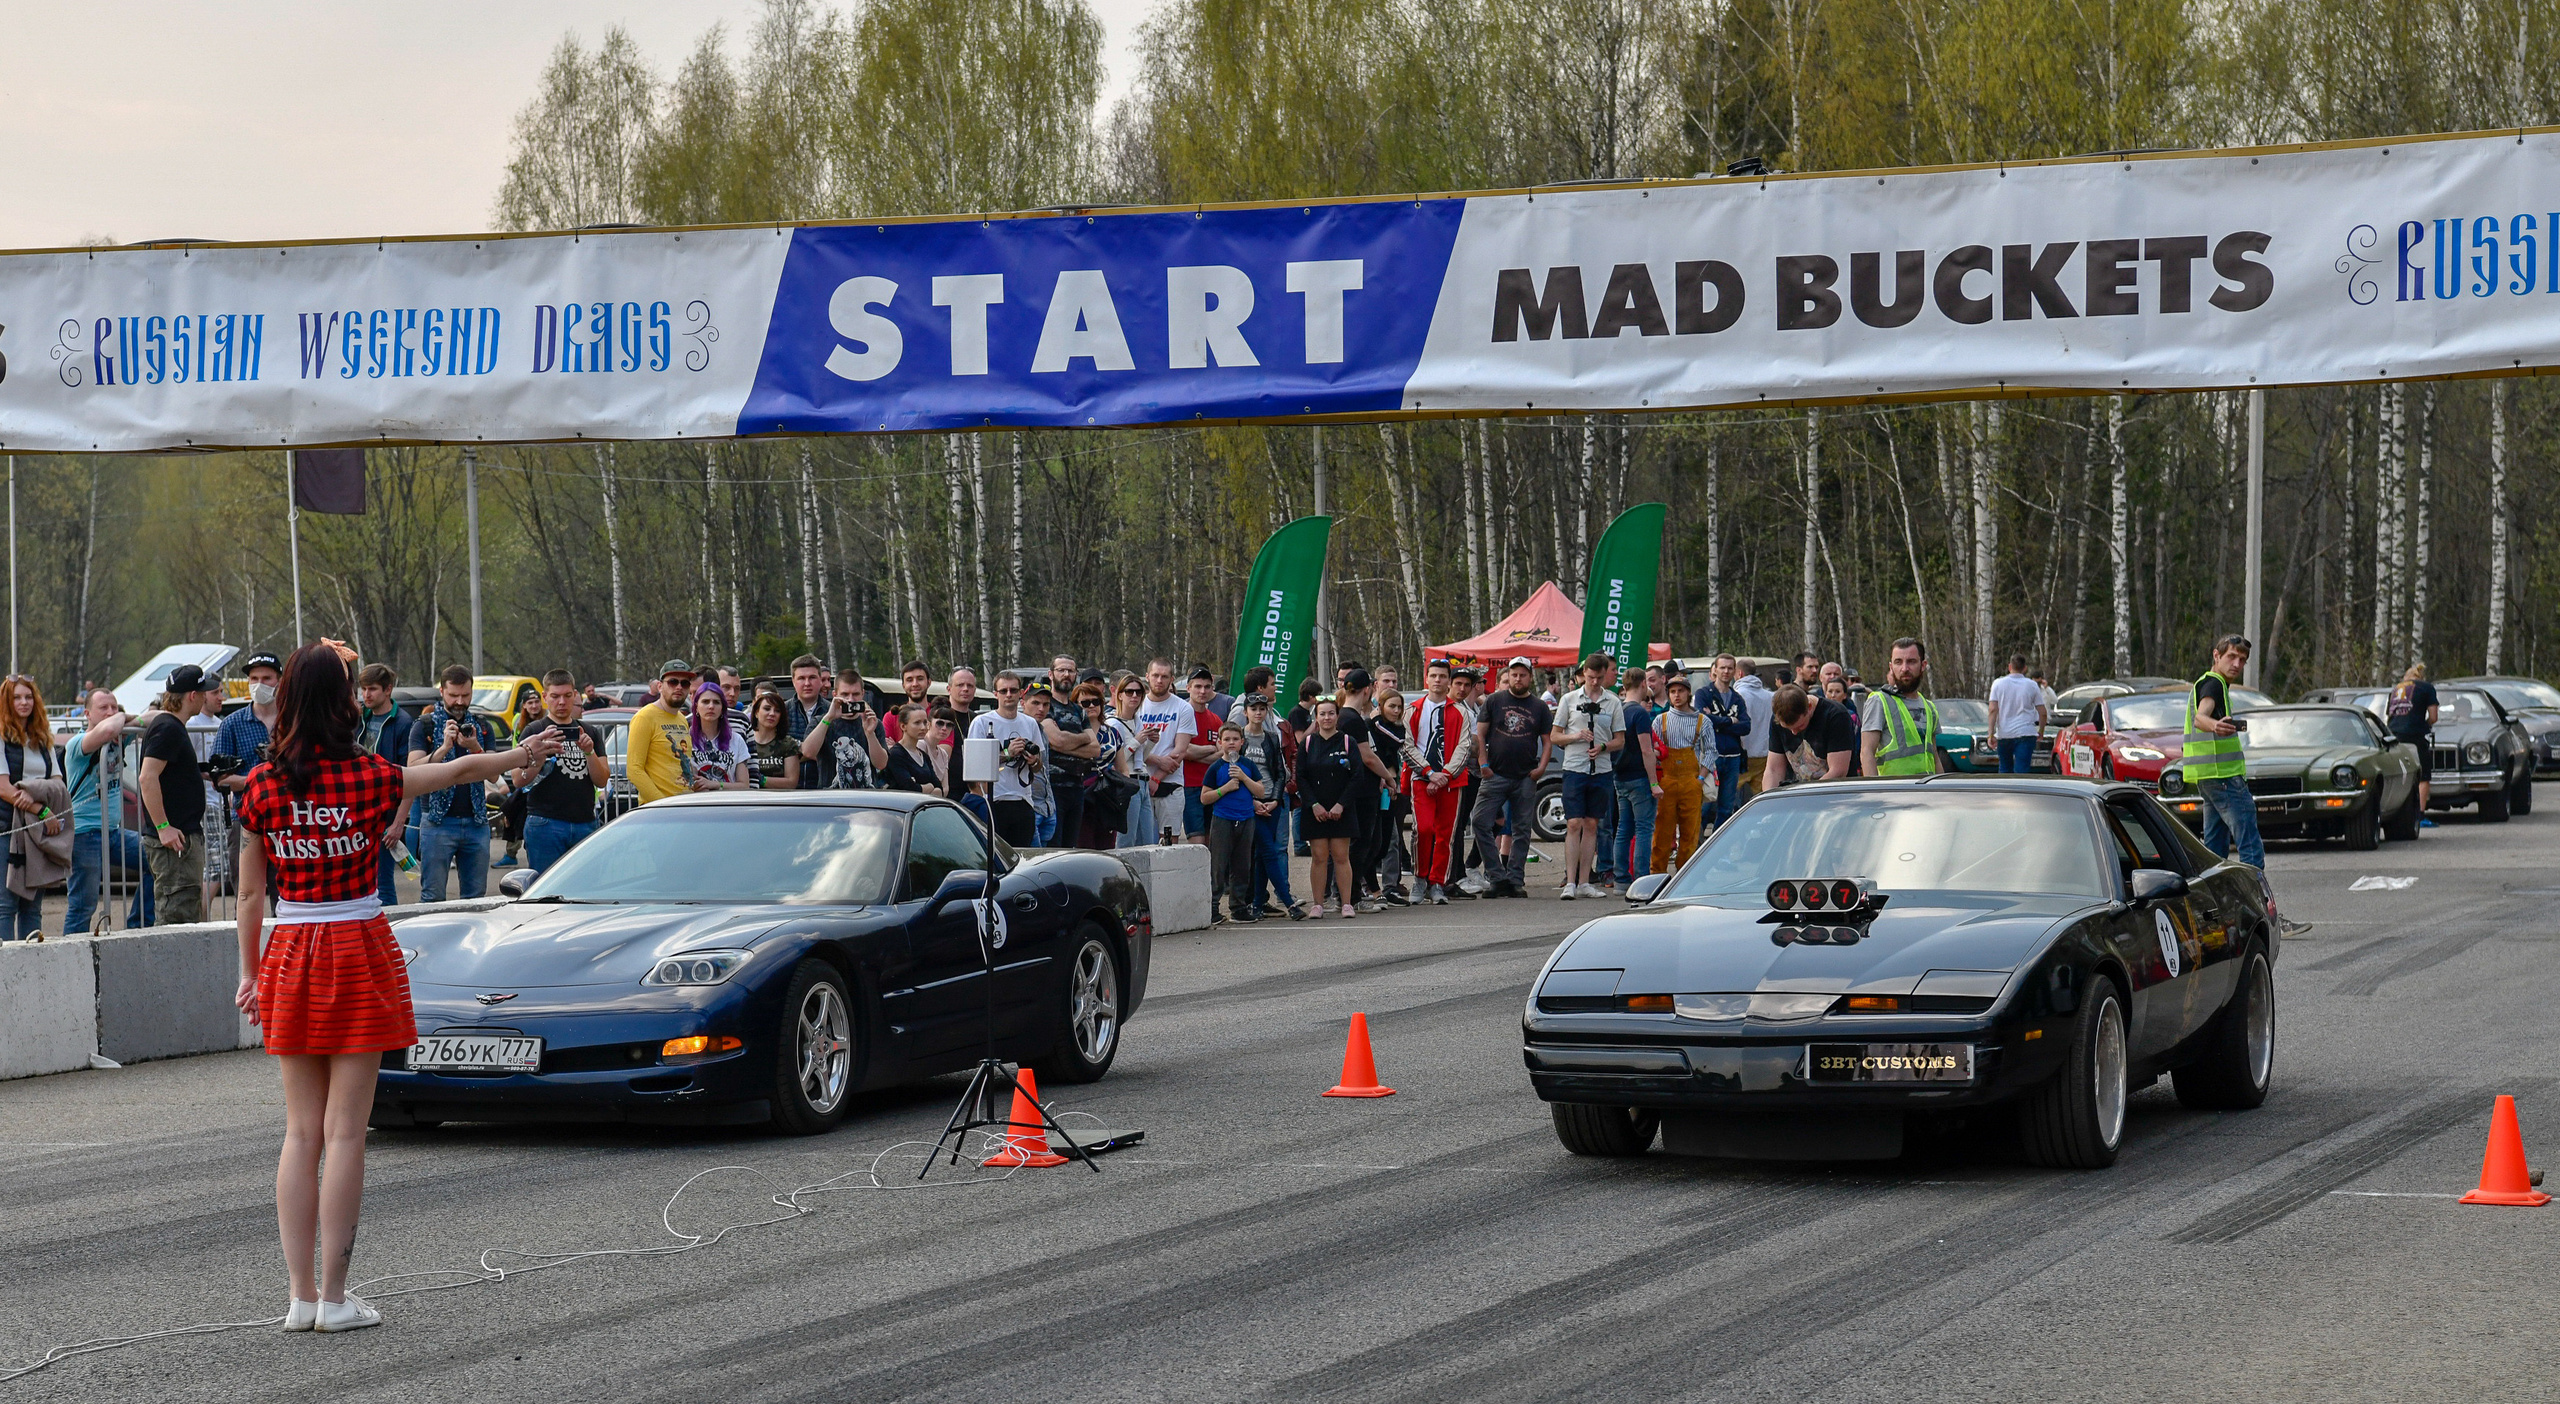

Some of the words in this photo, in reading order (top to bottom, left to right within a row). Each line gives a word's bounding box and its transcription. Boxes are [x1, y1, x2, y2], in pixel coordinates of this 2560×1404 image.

[1490, 259, 1746, 343] MAD
[1775, 230, 2274, 331] BUCKETS
[824, 258, 1364, 382] START
[93, 313, 265, 386] RUSSIAN
[299, 307, 501, 380] WEEKEND
[532, 301, 671, 373] DRAGS
[1259, 589, 1284, 666] EEDOM
[1602, 578, 1624, 657] EEDOM
[757, 755, 784, 766] nité
[289, 800, 354, 832] Hey,
[324, 831, 370, 859] me.
[2160, 922, 2174, 953] 11
[501, 1038, 535, 1058] 777
[506, 1057, 524, 1065] RUS
[1820, 1056, 1858, 1070] 3BT
[1862, 1056, 1958, 1070] CUSTOMS
